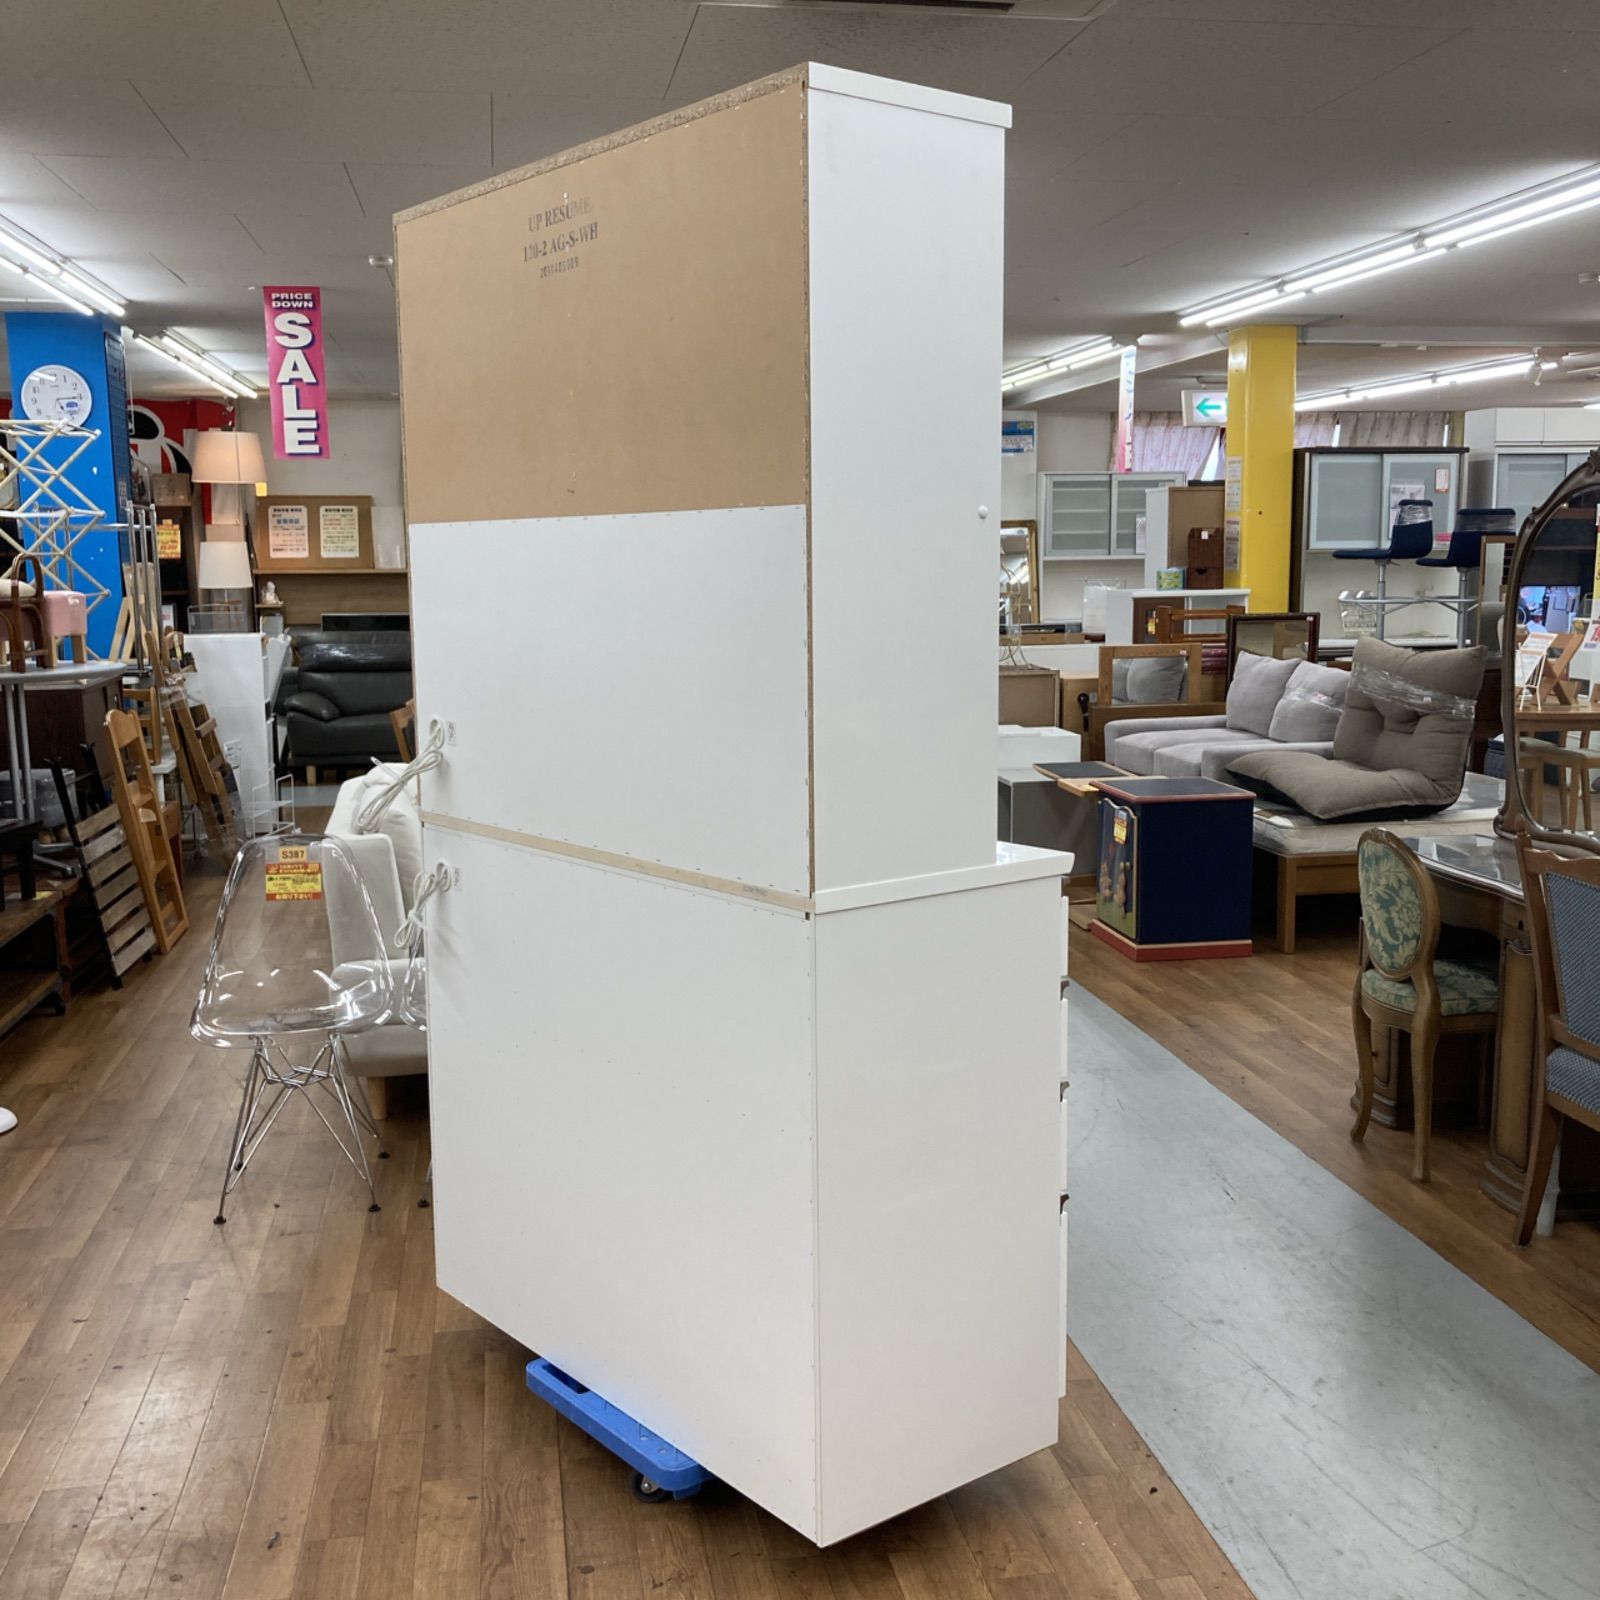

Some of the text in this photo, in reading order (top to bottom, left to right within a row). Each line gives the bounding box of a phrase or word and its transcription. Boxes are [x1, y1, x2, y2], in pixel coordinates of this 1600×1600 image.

[528, 196, 592, 232] UP RESUME
[271, 292, 313, 300] PRICE
[271, 300, 314, 309] DOWN
[274, 312, 320, 454] SALE
[281, 850, 305, 859] S387
